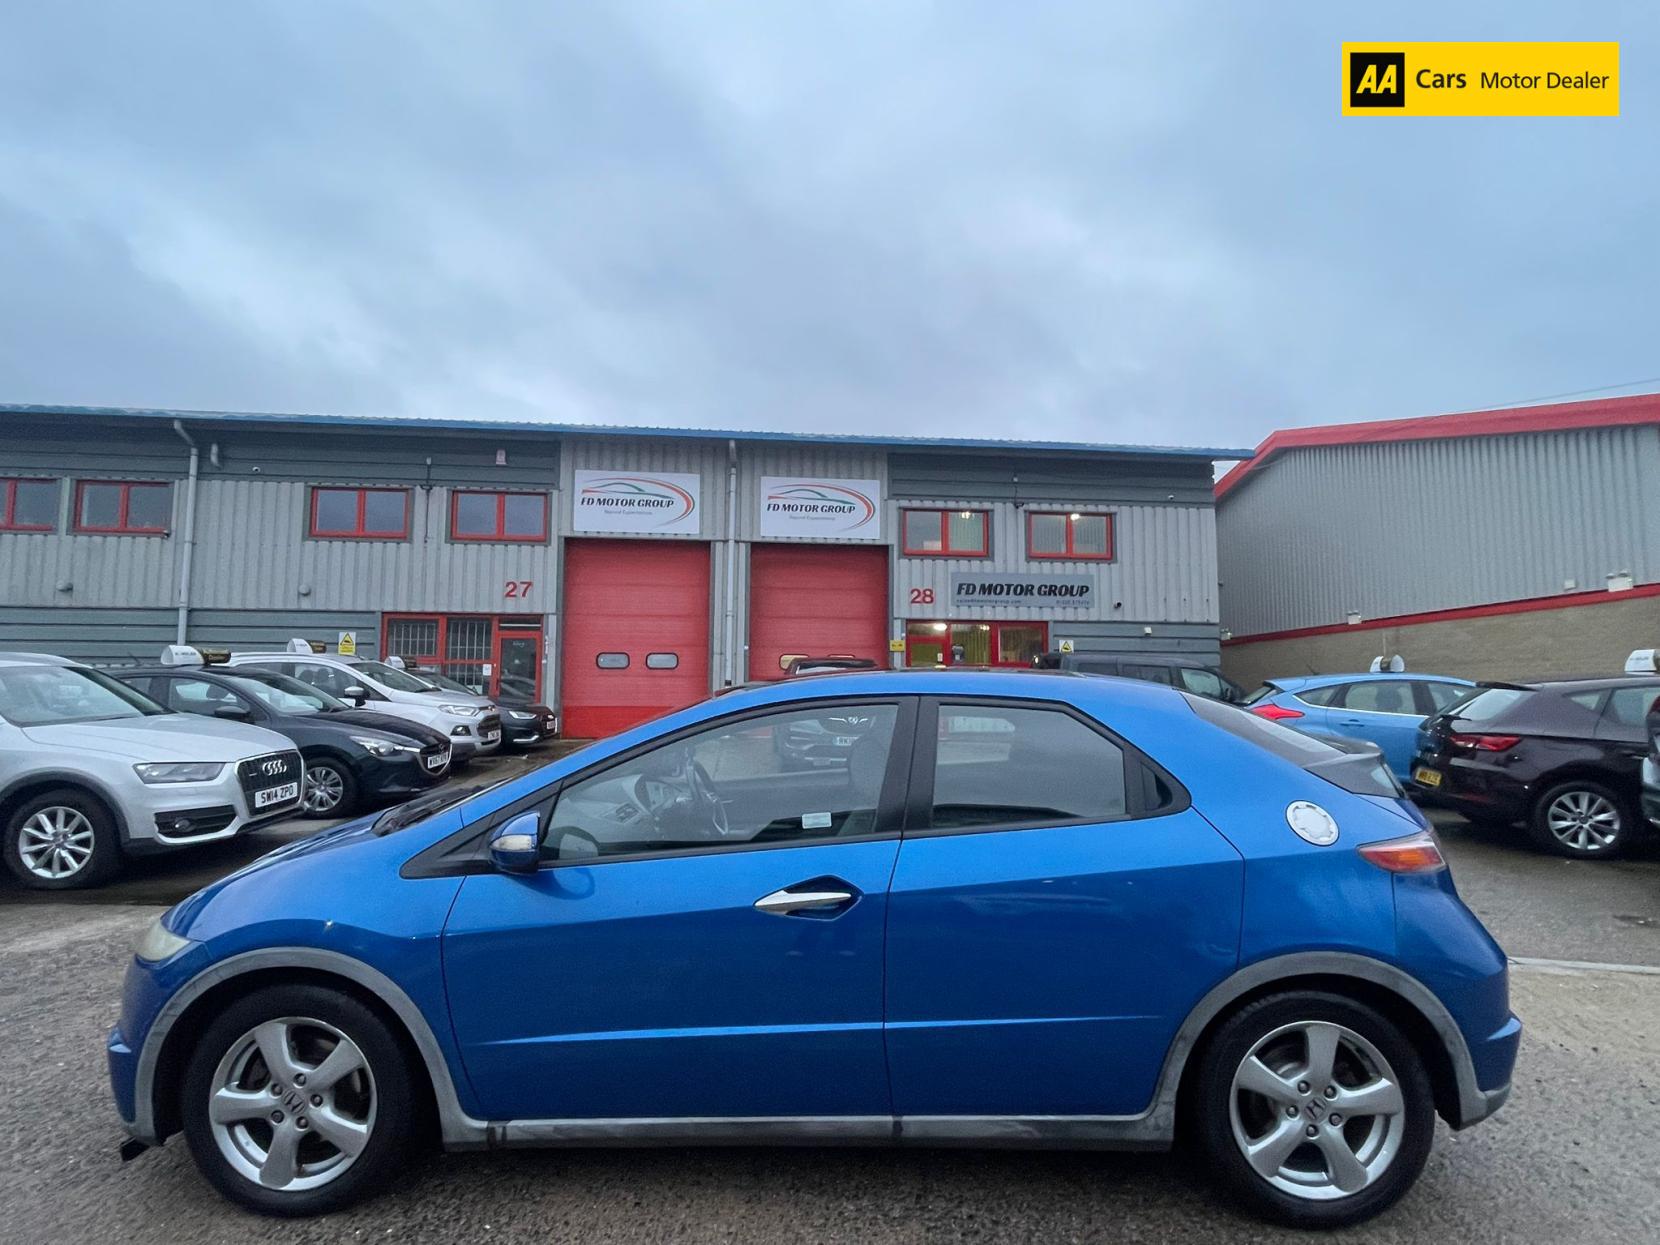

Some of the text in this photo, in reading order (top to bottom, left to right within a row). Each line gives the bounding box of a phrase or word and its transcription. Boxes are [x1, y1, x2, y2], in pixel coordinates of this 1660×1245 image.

[580, 497, 674, 508] FD MOTOR GROUP
[767, 503, 856, 514] FD MOTOR GROUP
[504, 581, 533, 598] 27
[910, 588, 934, 604] 28
[956, 582, 1090, 598] FD MOTOR GROUP
